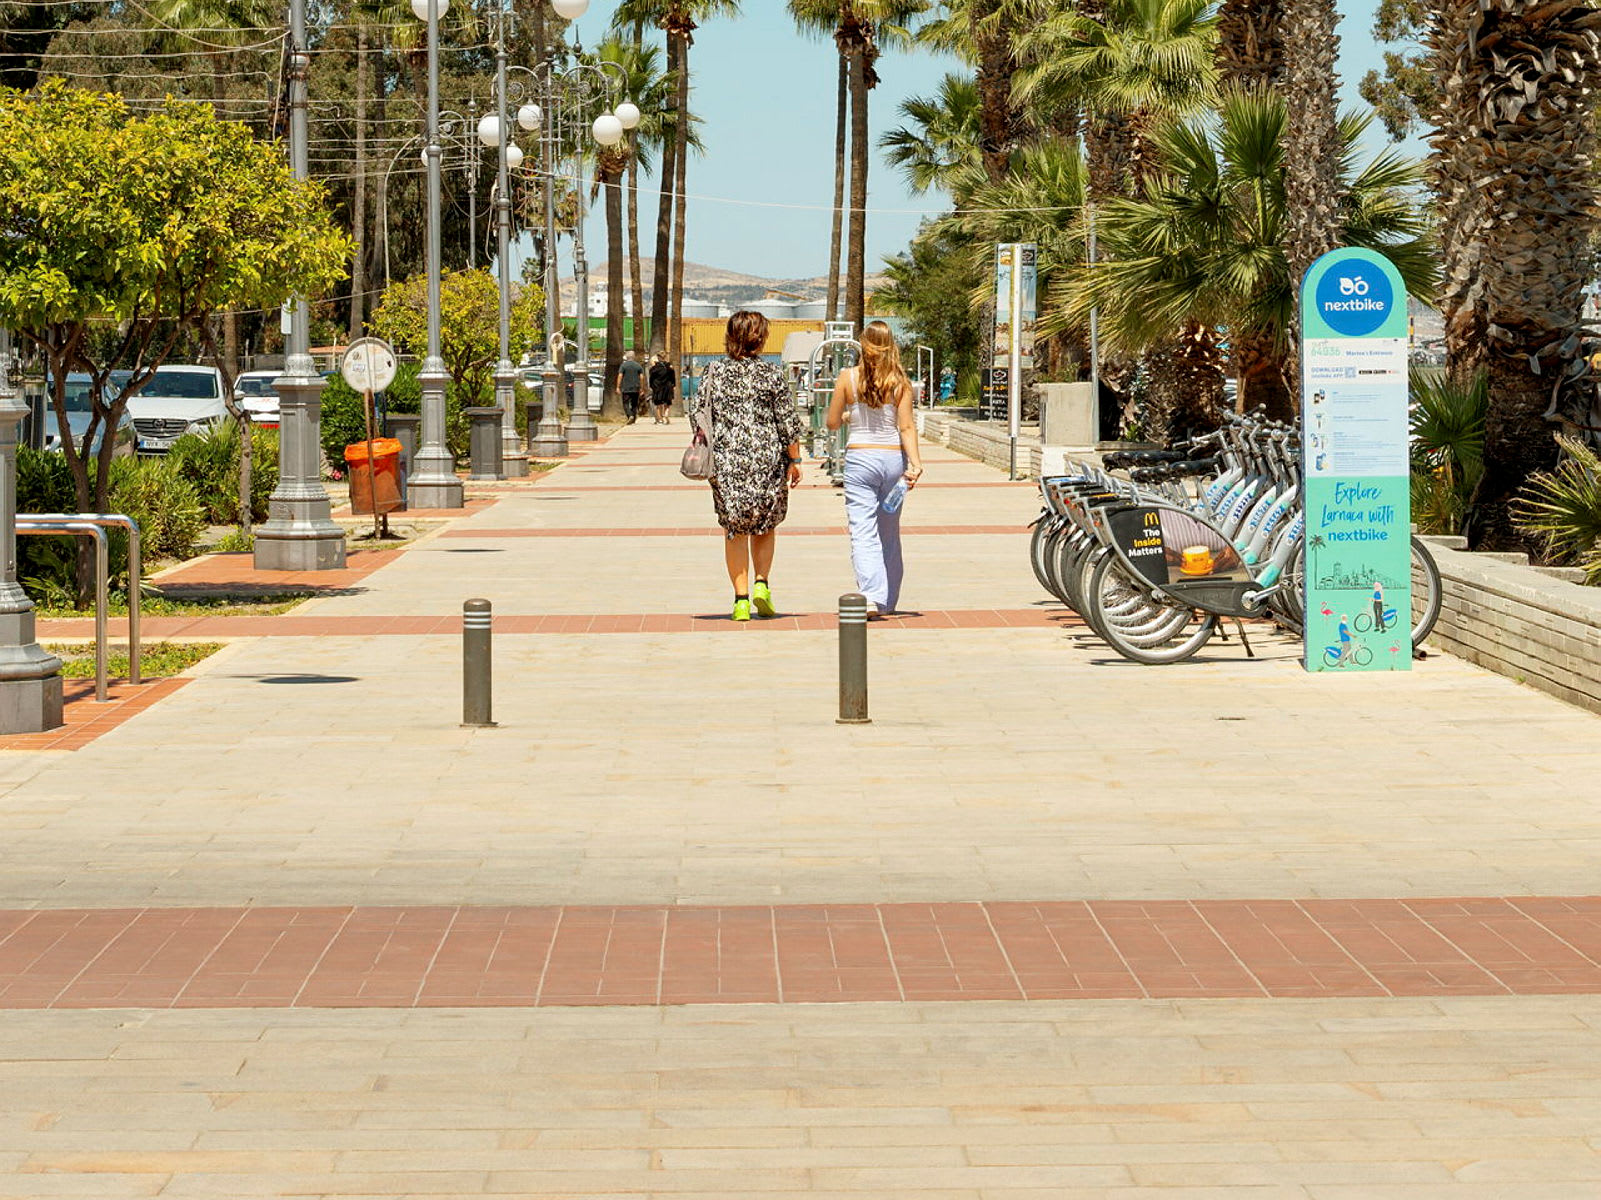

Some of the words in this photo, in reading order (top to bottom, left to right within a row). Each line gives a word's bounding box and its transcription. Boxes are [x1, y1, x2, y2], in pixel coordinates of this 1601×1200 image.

[1324, 298, 1384, 311] nextbike
[1335, 481, 1382, 506] Explore
[1321, 504, 1364, 528] Larnaca
[1368, 505, 1395, 526] with
[1142, 528, 1160, 538] The
[1328, 528, 1388, 541] nextbike
[1133, 537, 1162, 548] Inside
[1128, 546, 1163, 558] Matters
